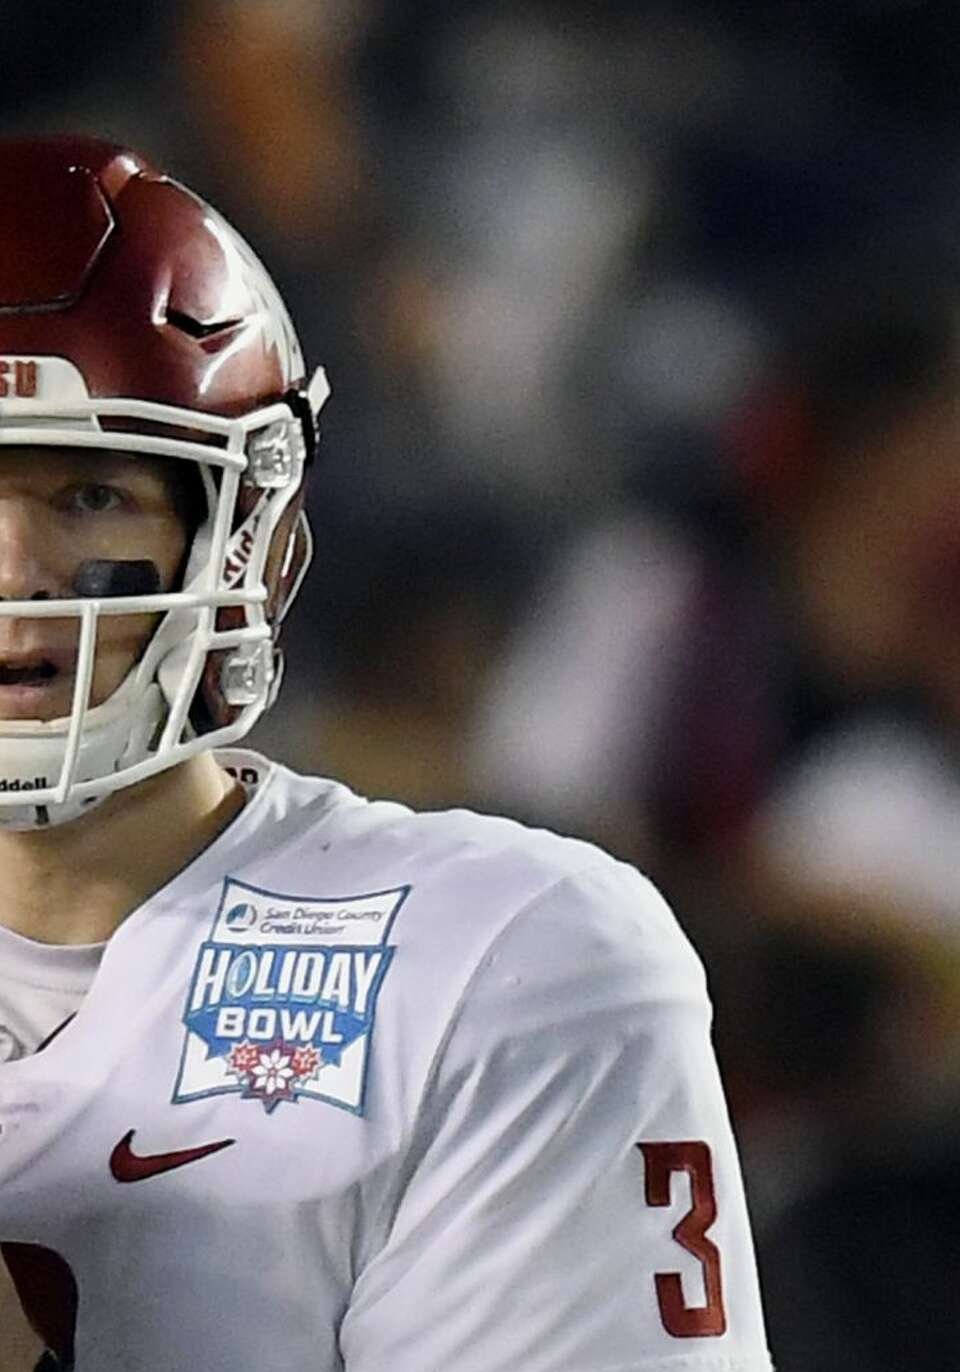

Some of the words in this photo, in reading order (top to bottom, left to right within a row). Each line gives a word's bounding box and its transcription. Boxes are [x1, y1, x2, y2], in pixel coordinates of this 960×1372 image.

[264, 907, 290, 920] San
[292, 907, 334, 921] Diego
[190, 948, 382, 1014] HOLIDAY
[216, 1006, 343, 1043] BOWL
[636, 1141, 727, 1337] 3
